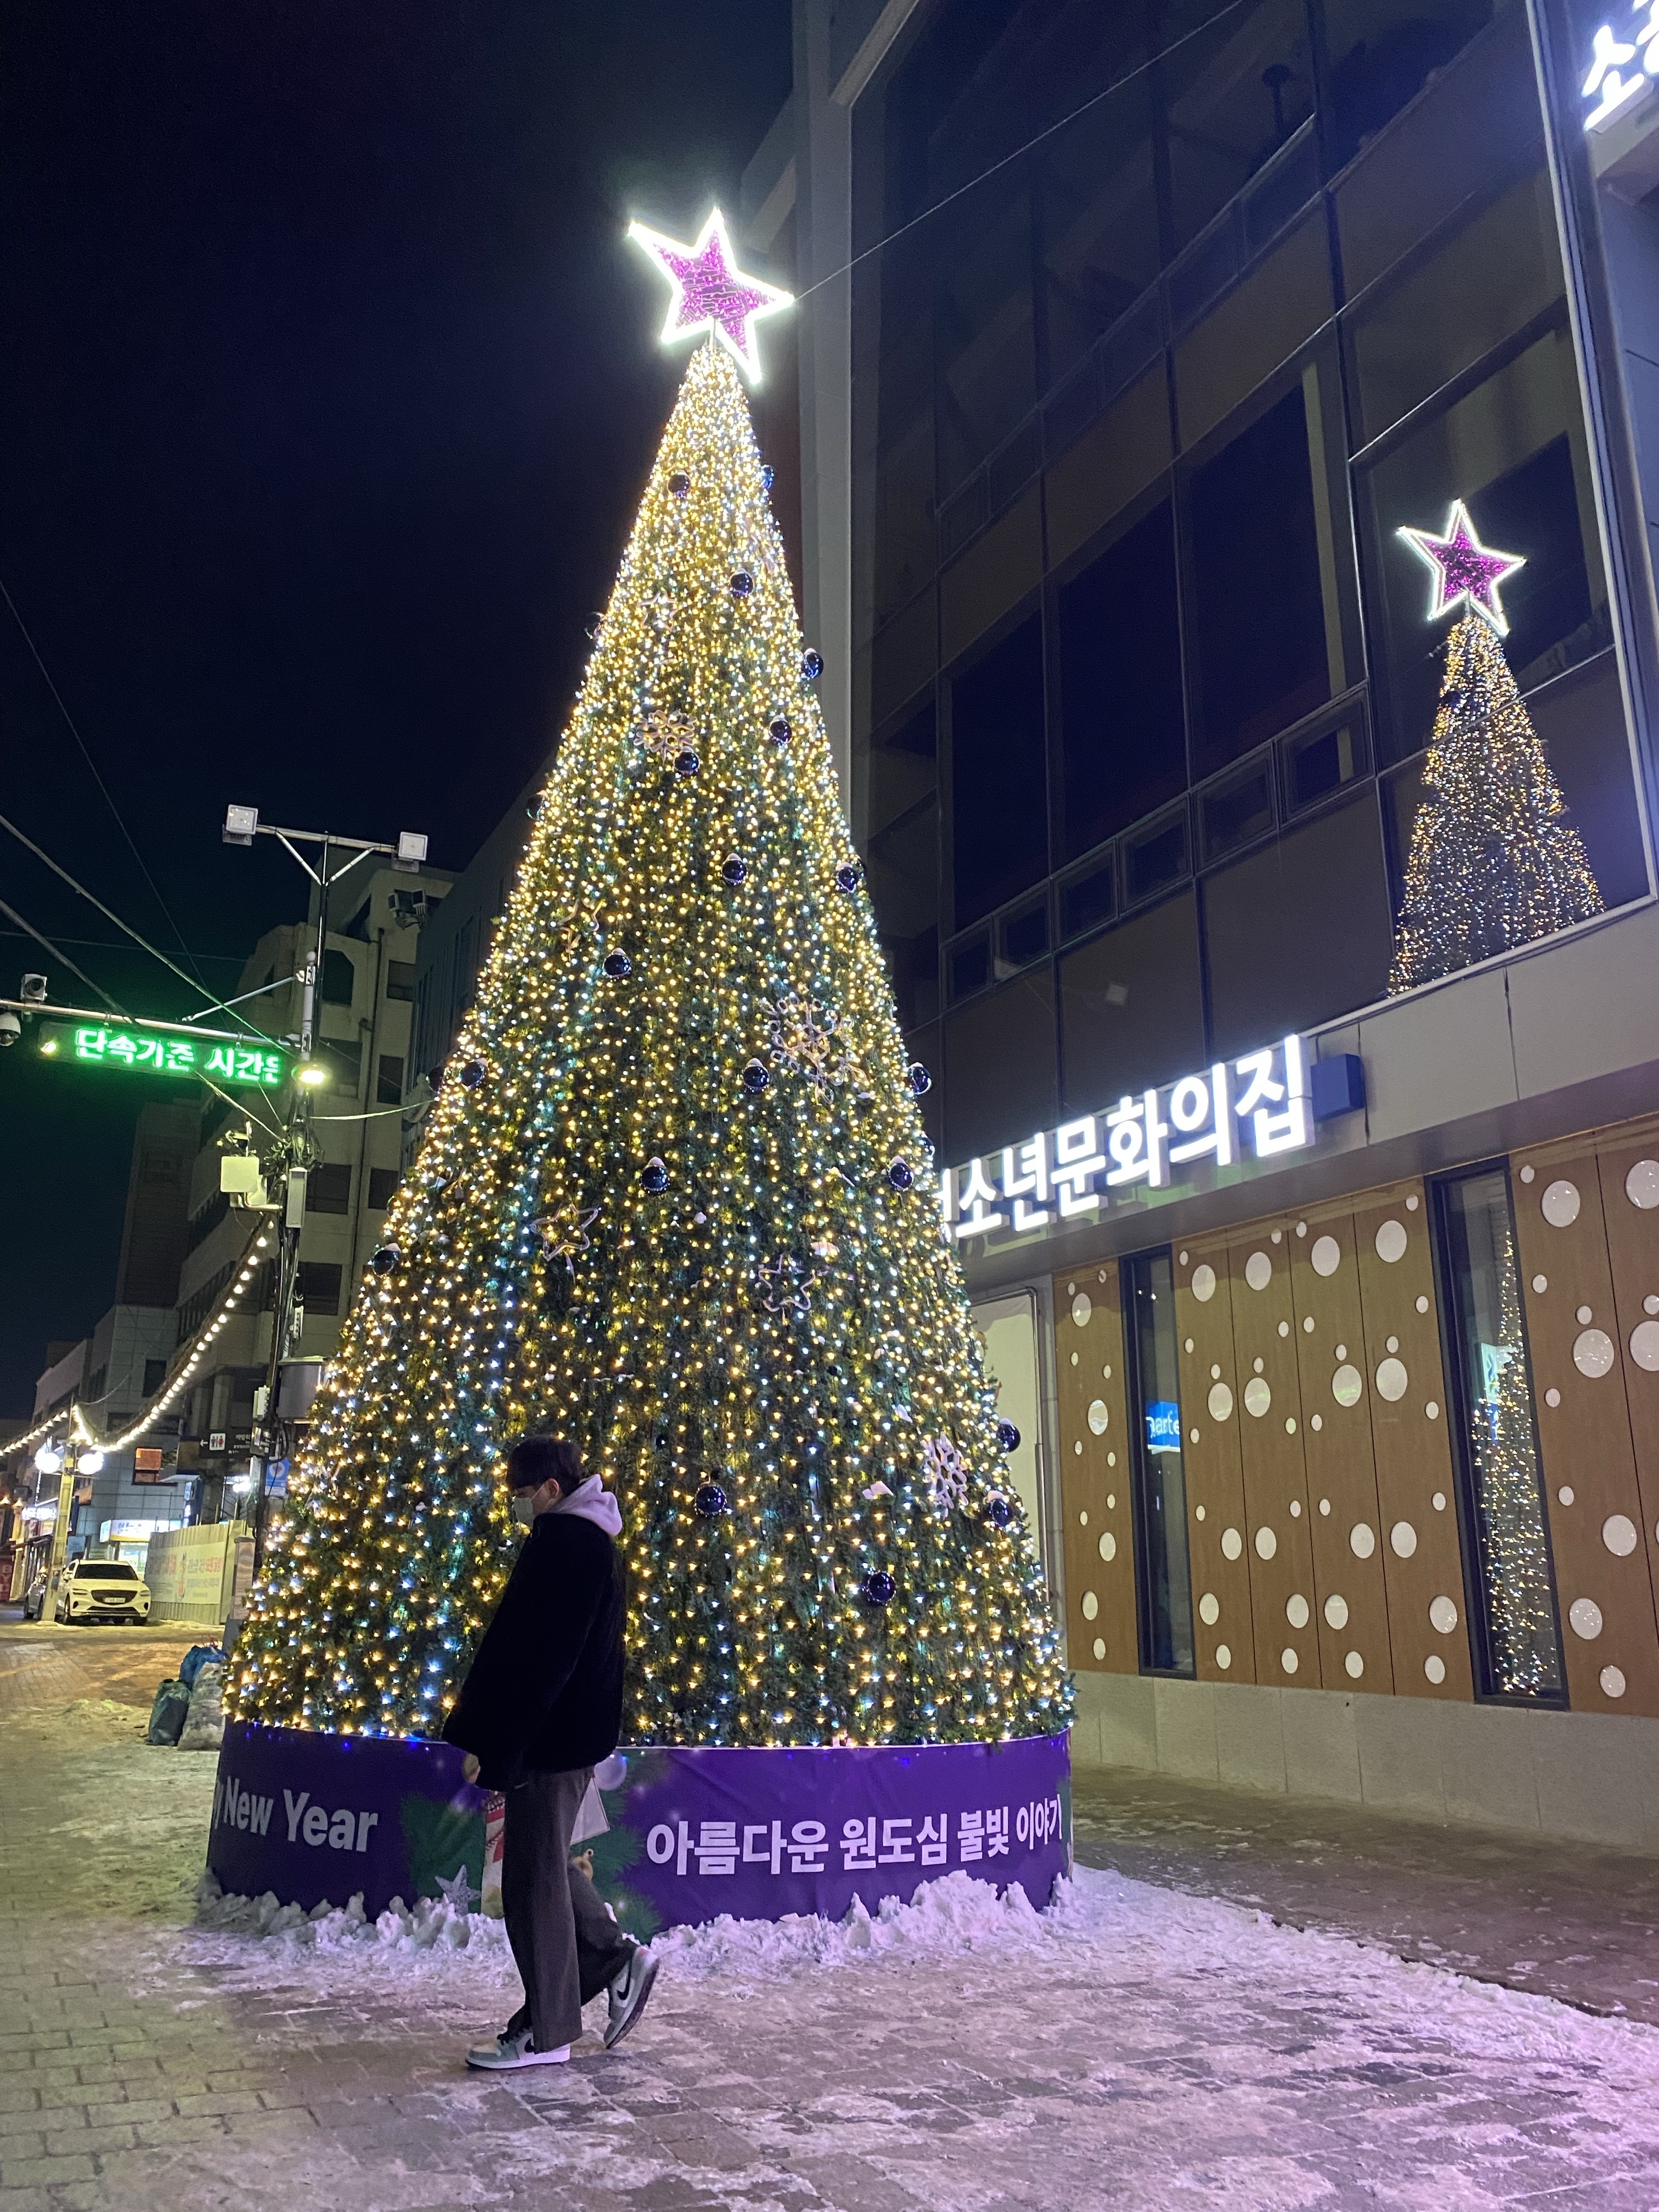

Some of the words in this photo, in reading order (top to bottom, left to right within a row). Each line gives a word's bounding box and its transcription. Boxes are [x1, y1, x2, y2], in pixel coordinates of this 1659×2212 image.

[76, 1028, 195, 1072] 단속기준
[223, 1776, 274, 1836] New
[283, 1788, 378, 1853] Year
[646, 1820, 829, 1876] 아름다운
[839, 1813, 948, 1871] 원도심
[957, 1805, 1010, 1863] 불빛
[1016, 1793, 1063, 1850] 이야기
